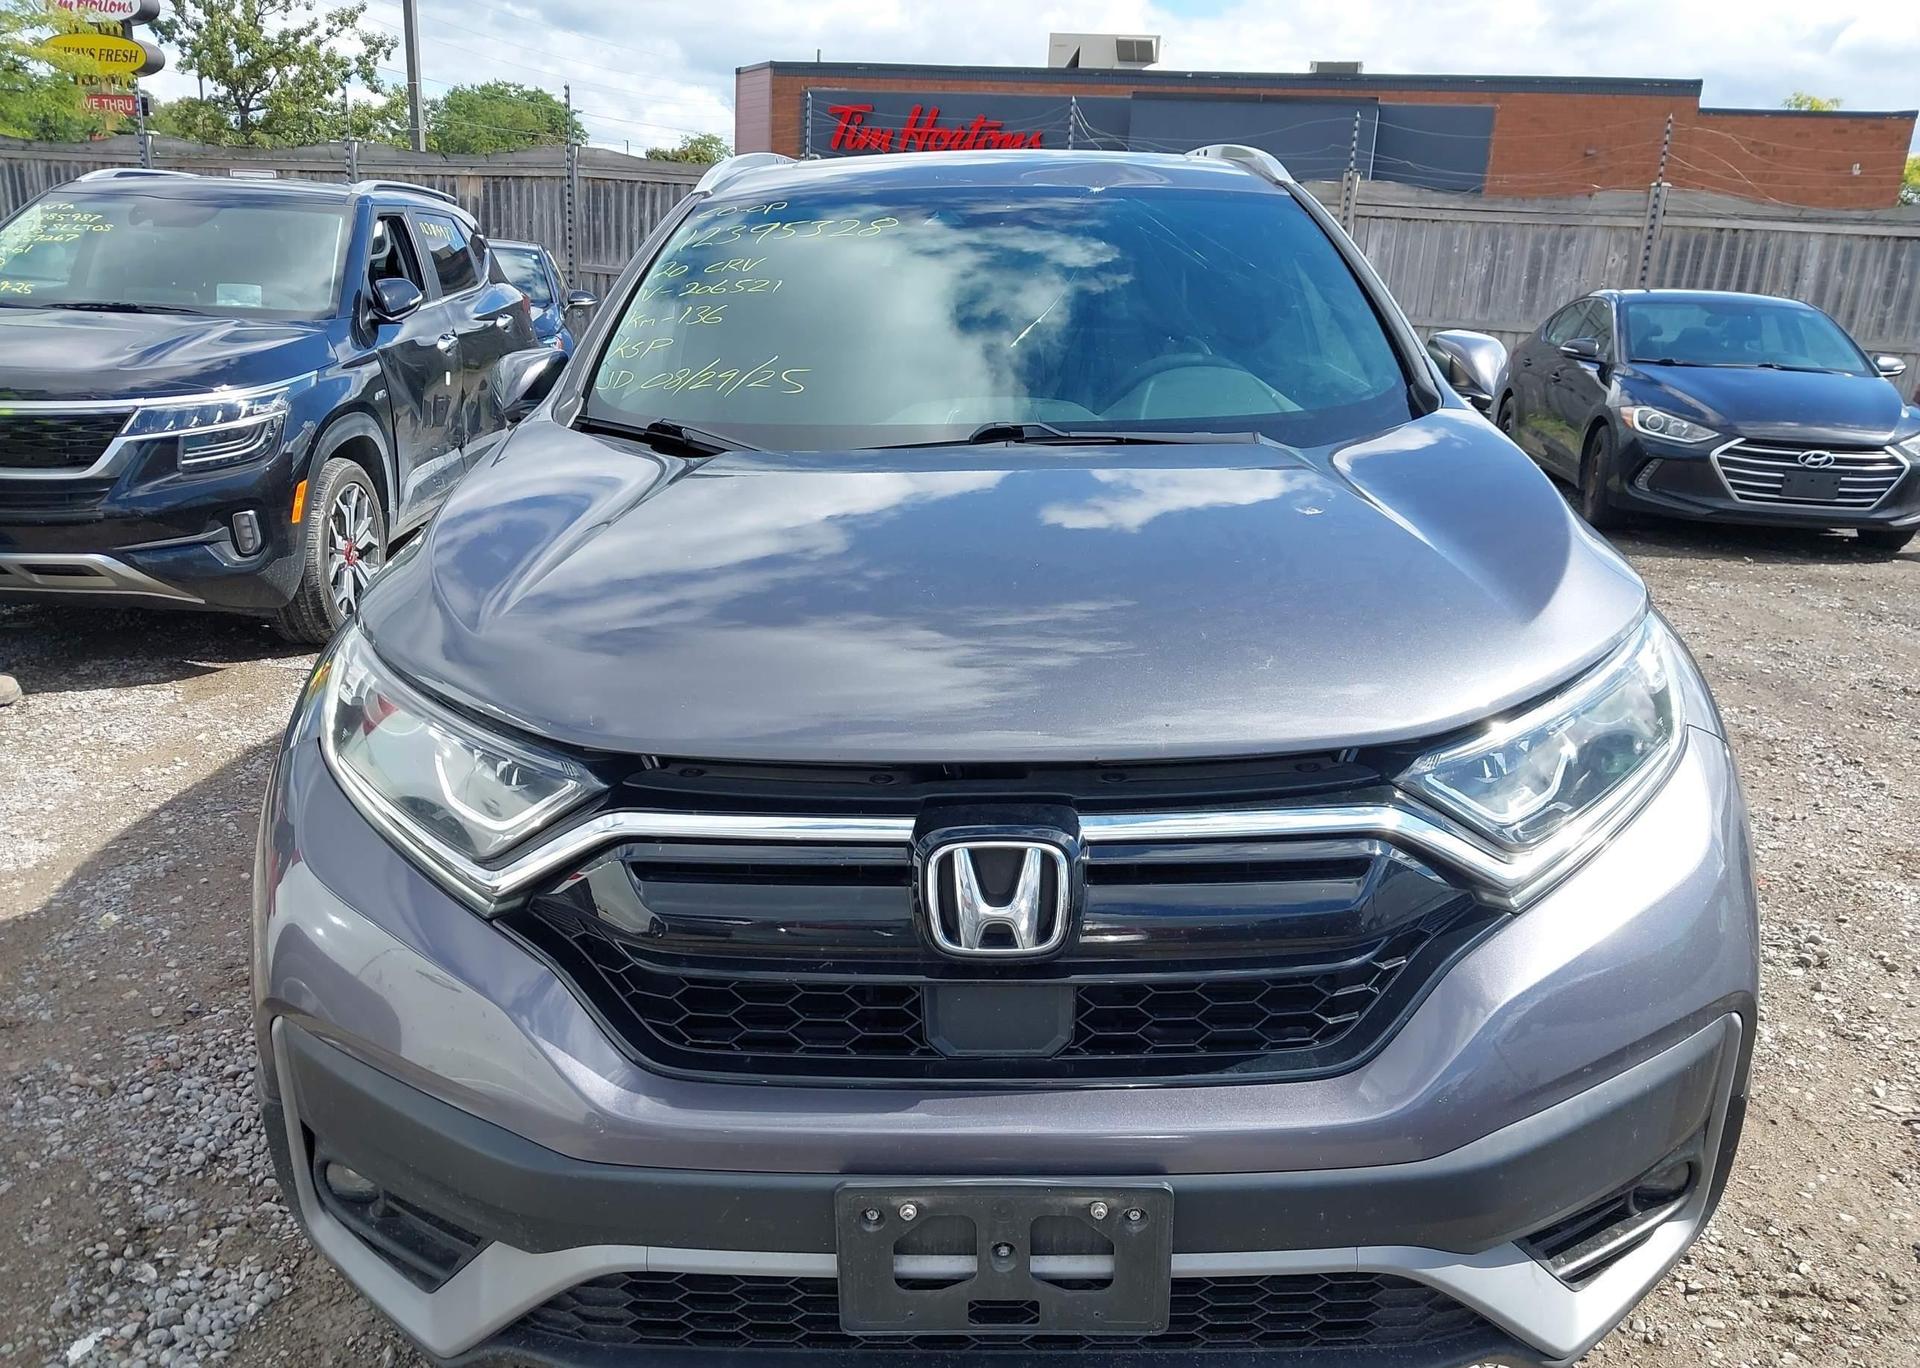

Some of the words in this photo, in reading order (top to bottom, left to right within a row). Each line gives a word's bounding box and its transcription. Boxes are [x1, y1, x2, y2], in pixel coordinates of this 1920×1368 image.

[98, 48, 138, 63] FRESH
[102, 99, 133, 111] THRU
[828, 104, 887, 152] Tim
[900, 103, 1044, 151] Hortons
[696, 201, 788, 221] CO-OP
[678, 217, 899, 251] 12395328
[640, 354, 813, 399] 08/29/25
